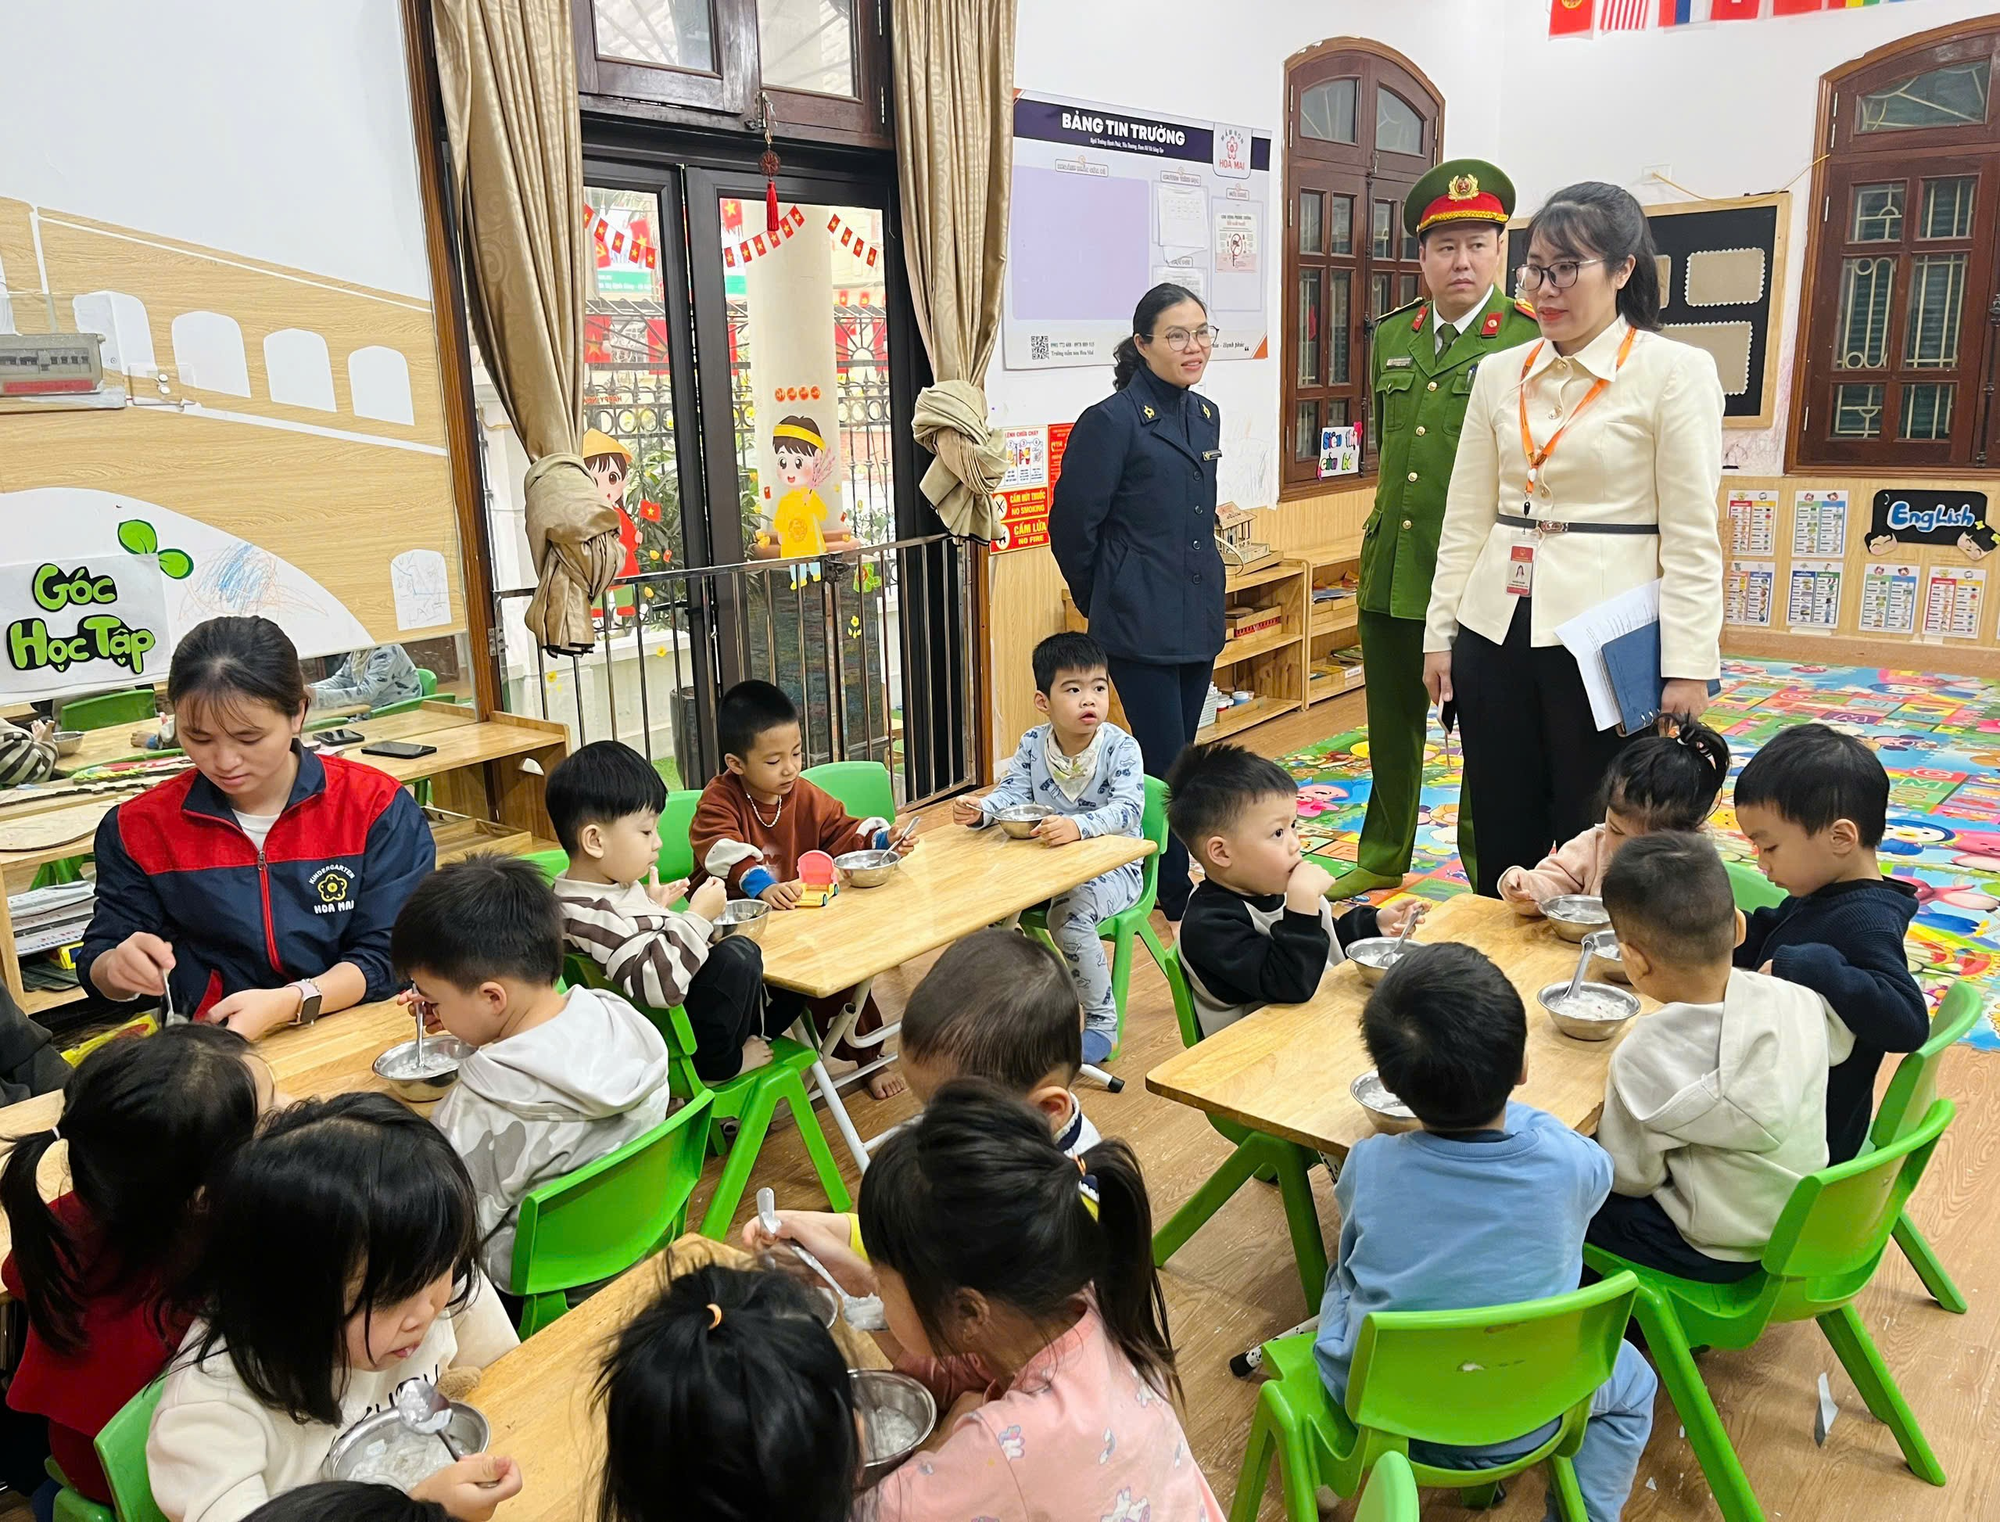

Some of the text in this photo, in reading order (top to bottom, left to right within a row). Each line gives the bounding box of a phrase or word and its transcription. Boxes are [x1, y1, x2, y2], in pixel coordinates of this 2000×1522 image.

[1062, 110, 1186, 146] BẢNG TIN TRƯỜNG
[1219, 158, 1245, 170] HOA MAI
[1011, 504, 1045, 516] NO SMOKING
[1013, 519, 1047, 536] CẤM LỬA
[1018, 534, 1044, 545] NO FIRE
[32, 563, 117, 612] Góc
[8, 615, 156, 674] Học Tập
[1899, 777, 1943, 789] M
[308, 863, 355, 885] KINDERGARTEN
[313, 903, 336, 914] HOA
